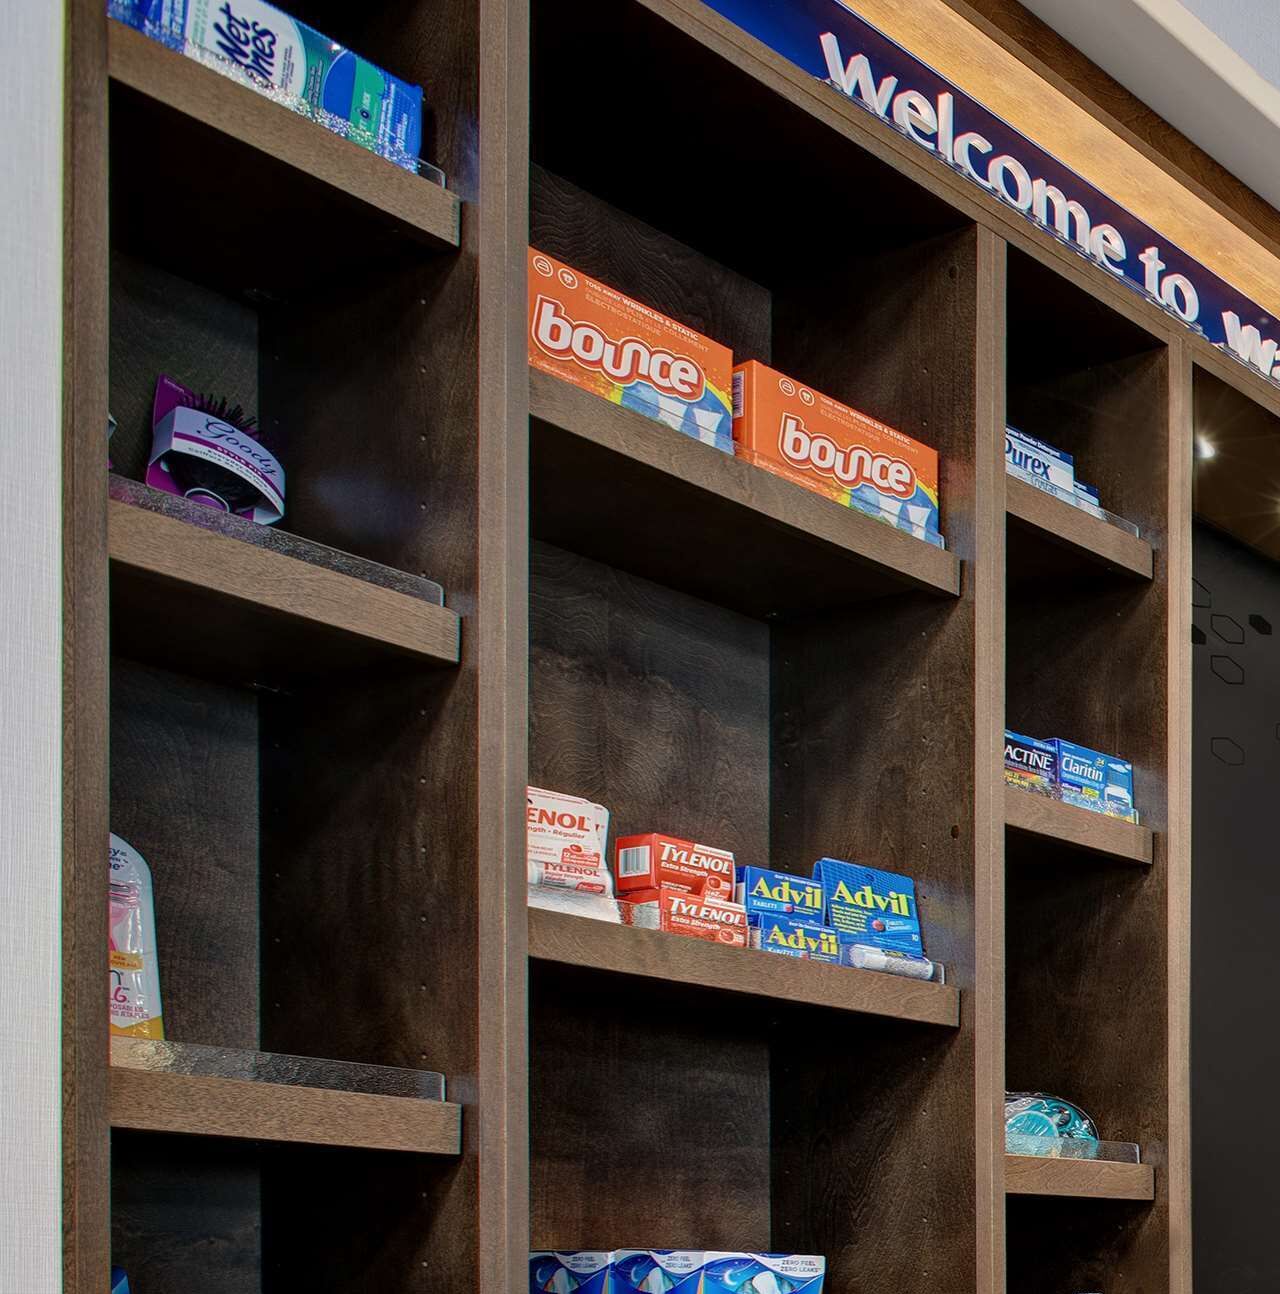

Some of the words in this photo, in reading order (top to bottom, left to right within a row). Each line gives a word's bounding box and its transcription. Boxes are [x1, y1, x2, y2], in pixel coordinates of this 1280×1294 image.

[820, 32, 1126, 277] welcome
[1139, 245, 1201, 323] to
[622, 298, 664, 323] WRINKLES
[672, 323, 698, 340] STATIC
[537, 301, 699, 394] bounce
[197, 418, 277, 475] Goody
[783, 417, 911, 492] bounce
[1005, 745, 1054, 771] ACTINE
[1062, 756, 1103, 782] Claritin
[528, 808, 590, 832] ENOL
[543, 862, 601, 877] TYLENOL
[659, 842, 730, 874] TYLENOL
[751, 877, 823, 909] Advil
[831, 880, 911, 917] Advil
[668, 896, 747, 927] TYLENOL
[768, 924, 839, 956] Advil
